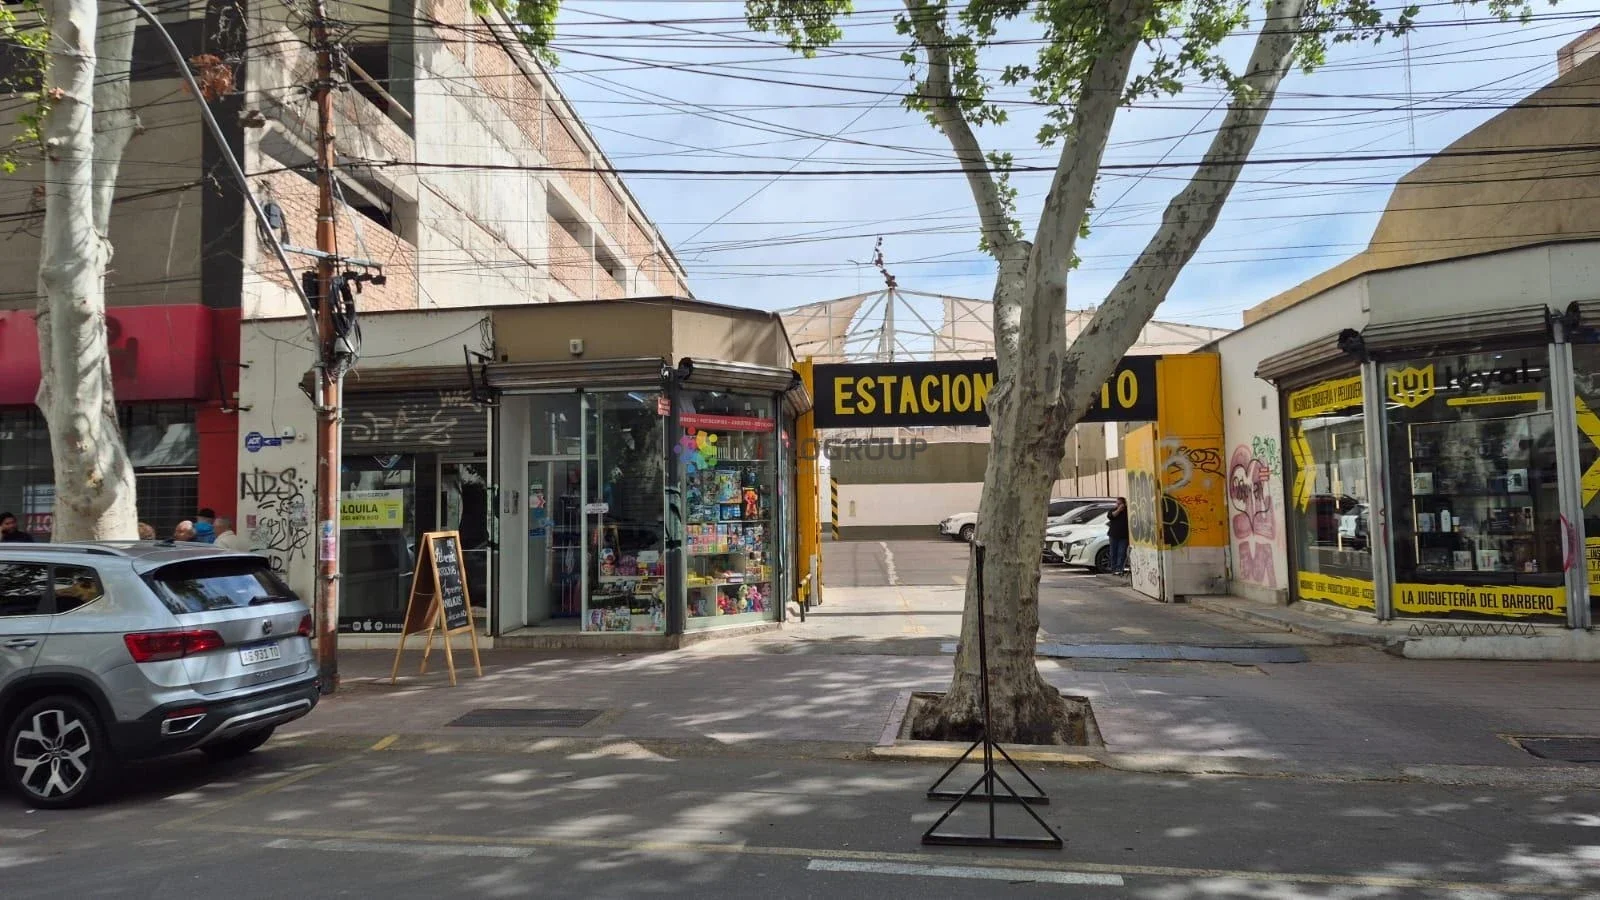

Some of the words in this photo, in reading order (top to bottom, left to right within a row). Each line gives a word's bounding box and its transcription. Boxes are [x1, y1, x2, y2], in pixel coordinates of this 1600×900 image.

[834, 369, 1138, 415] ESTACIONTO
[340, 503, 378, 514] LQUILA
[1402, 590, 1414, 605] LA
[1417, 589, 1477, 607] JUGUETERÍA
[1480, 593, 1498, 608] DEL
[1502, 594, 1554, 610] BARBERO
[254, 649, 269, 661] 931
